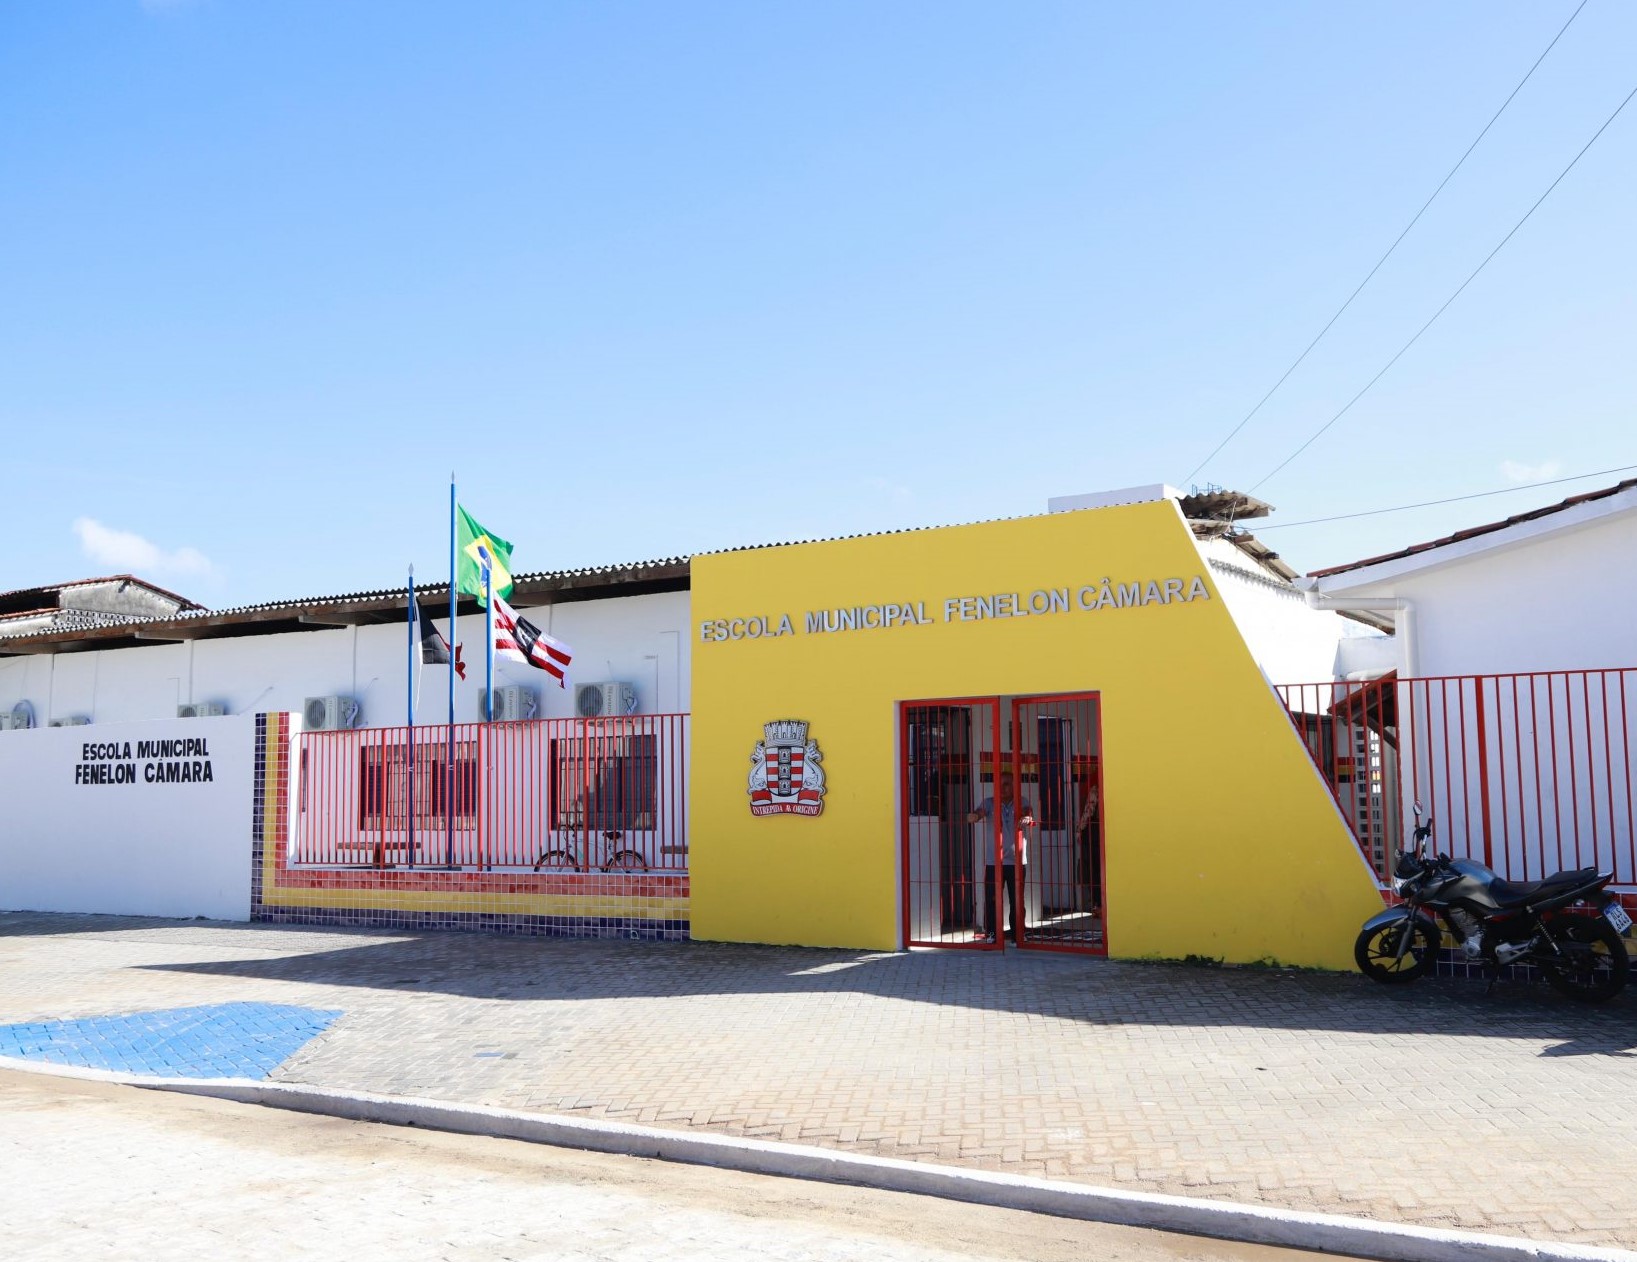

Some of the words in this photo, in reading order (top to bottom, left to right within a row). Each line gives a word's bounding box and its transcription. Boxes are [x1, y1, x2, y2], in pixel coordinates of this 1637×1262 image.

[700, 614, 795, 643] ESCOLA
[805, 601, 934, 634] MUNICIPAL
[944, 588, 1070, 623] FENELON
[1077, 576, 1210, 612] CÂMARA
[83, 742, 131, 760] ESCOLA
[137, 738, 209, 758] MUNICIPAL
[75, 763, 136, 784] FENELON
[144, 758, 214, 783] CÂMARA
[752, 804, 783, 815] INTREPIDA
[793, 805, 819, 815] ORIGINE
